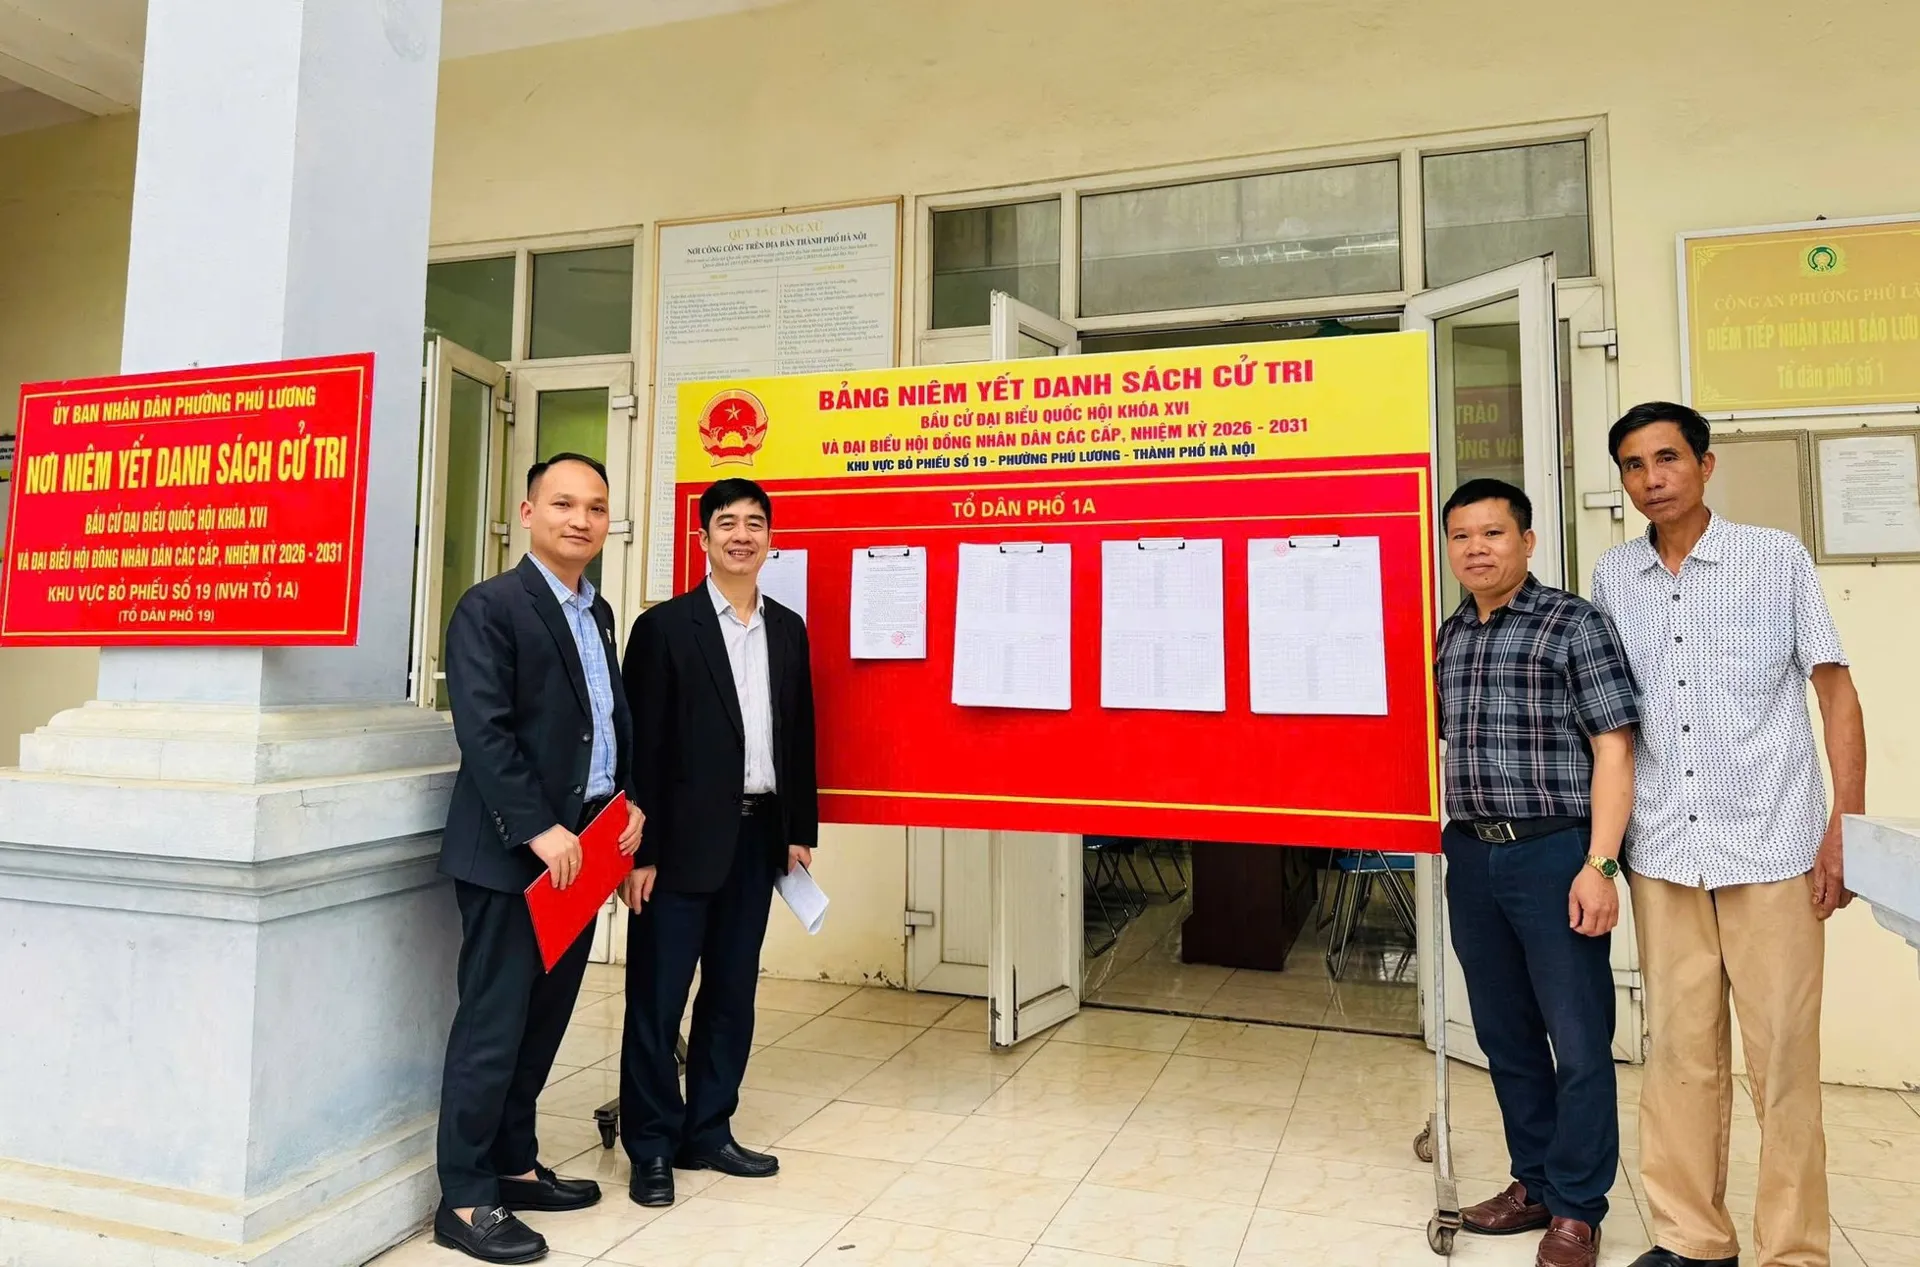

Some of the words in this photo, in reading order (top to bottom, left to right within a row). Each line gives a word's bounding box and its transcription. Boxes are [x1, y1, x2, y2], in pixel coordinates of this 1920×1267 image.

[1713, 293, 1760, 312] CÔNG
[1763, 293, 1785, 308] AN
[1789, 286, 1859, 307] PHƯỜNG
[1863, 282, 1897, 302] PHÚ
[819, 380, 890, 411] BẢNG
[898, 379, 967, 406] NIÊM
[976, 371, 1024, 402] YẾT
[1033, 372, 1112, 399] DANH
[1121, 365, 1202, 394] SÁCH
[1213, 353, 1259, 388] CỬ
[1264, 359, 1313, 385] TRI
[1876, 360, 1885, 386] 1
[53, 399, 70, 426] ỦY
[72, 403, 100, 424] BAN
[102, 396, 141, 422] NHÂN
[143, 394, 172, 419] DÂN
[174, 389, 232, 417] PHƯỜNG
[235, 385, 265, 412] PHÚ
[267, 384, 317, 410] LƯƠNG
[920, 410, 949, 429] BẦU
[953, 407, 974, 428] CỬ
[976, 411, 1000, 429] ĐẠI
[1005, 404, 1038, 425] BIỂU
[1042, 402, 1082, 424] QUỐC
[1087, 402, 1112, 423] HỘI
[1117, 400, 1160, 419] KHÓA
[1164, 400, 1190, 416] XVI
[822, 438, 840, 455] VÀ
[843, 440, 866, 457] ĐẠI
[870, 433, 901, 453] BIỂU
[905, 434, 929, 454] HỘI
[932, 431, 972, 451] ĐỒNG
[976, 430, 1017, 449] NHÂN
[1021, 429, 1051, 447] DÂN
[1056, 427, 1086, 445] CÁC
[1091, 423, 1127, 443] CẤP,
[1130, 421, 1183, 443] NHIỆM
[1187, 420, 1208, 439] KỲ
[1212, 420, 1253, 437] 2026
[1269, 418, 1308, 434] 2031
[1456, 432, 1490, 461] ỐNG
[25, 451, 59, 495] NƠI
[62, 443, 113, 493] NIÊM
[118, 433, 153, 490] YẾT
[155, 444, 212, 488] DANH
[216, 433, 274, 485] SÁCH
[277, 419, 312, 482] CỬ
[313, 434, 348, 480] TRI
[846, 460, 870, 473] KHU
[872, 458, 895, 473] VỰC
[897, 455, 914, 470] BỎ
[916, 454, 951, 469] PHIẾU
[953, 452, 971, 467] SỐ
[973, 456, 988, 467] 19
[998, 450, 1048, 466] PHƯỜNG
[1051, 449, 1076, 464] PHÚ
[1080, 449, 1121, 462] LƯƠNG
[1133, 445, 1175, 460] THÀNH
[1179, 441, 1206, 458] PHỐ
[1210, 442, 1228, 456] HÀ
[1231, 441, 1256, 458] NỘI
[123, 511, 141, 538] ĐẠI
[142, 502, 166, 533] BIỂU
[167, 502, 196, 534] QUỐC
[197, 504, 216, 536] HỘI
[217, 503, 246, 530] KHÓA
[248, 506, 269, 529] XVI
[952, 491, 977, 518] TỔ
[980, 496, 1022, 517] DÂN
[1027, 491, 1066, 516] PHỐ
[1072, 497, 1096, 514] 1A
[17, 548, 30, 571] VÀ
[31, 551, 48, 575] ĐẠI
[49, 543, 72, 571] BIỂU
[73, 545, 91, 573] HỘI
[120, 543, 150, 568] NHÂN
[151, 543, 174, 567] DÂN
[175, 541, 196, 567] CÁC
[224, 539, 260, 570] NHIỆM
[261, 539, 277, 564] KỲ
[278, 543, 306, 564] 2026
[315, 542, 343, 563] 2031
[48, 585, 75, 603] KHU
[78, 584, 105, 607] VỰC
[107, 577, 127, 601] BỎ
[129, 576, 169, 601] PHIẾU
[172, 575, 192, 600] SỐ
[195, 583, 212, 600] 19
[214, 582, 249, 602] (NVH
[252, 571, 272, 599] TỔ
[276, 581, 299, 600] 1A)
[118, 603, 138, 623] (TỔ
[140, 606, 167, 622] DÂN
[169, 604, 194, 622] PHỐ
[198, 609, 215, 623] 19)
